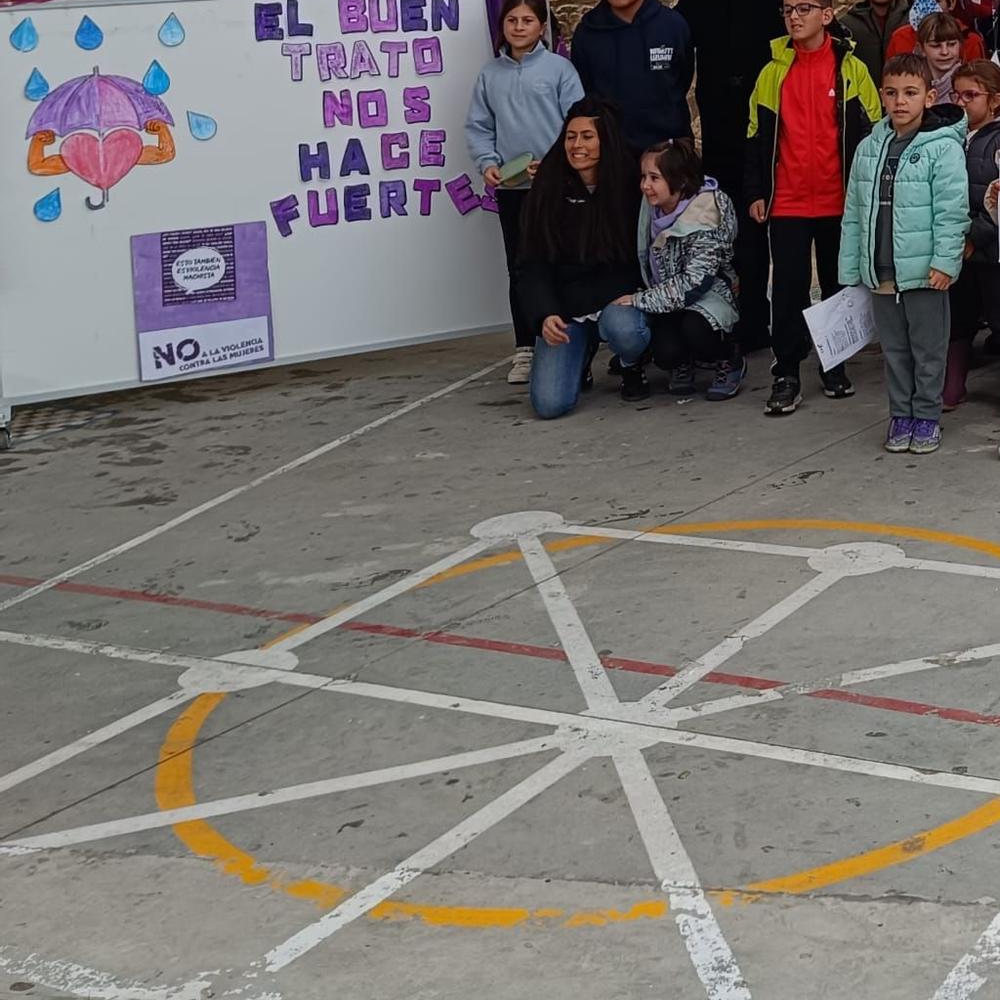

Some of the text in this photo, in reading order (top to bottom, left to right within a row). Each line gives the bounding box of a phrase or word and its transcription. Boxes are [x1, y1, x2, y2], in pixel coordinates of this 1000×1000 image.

[281, 36, 444, 82] TRATO
[322, 86, 431, 128] NOS
[299, 130, 446, 182] HACE
[153, 337, 264, 369] NO A LA VIOLENCIA
[179, 344, 265, 372] CONTRA LAS MUJERES
